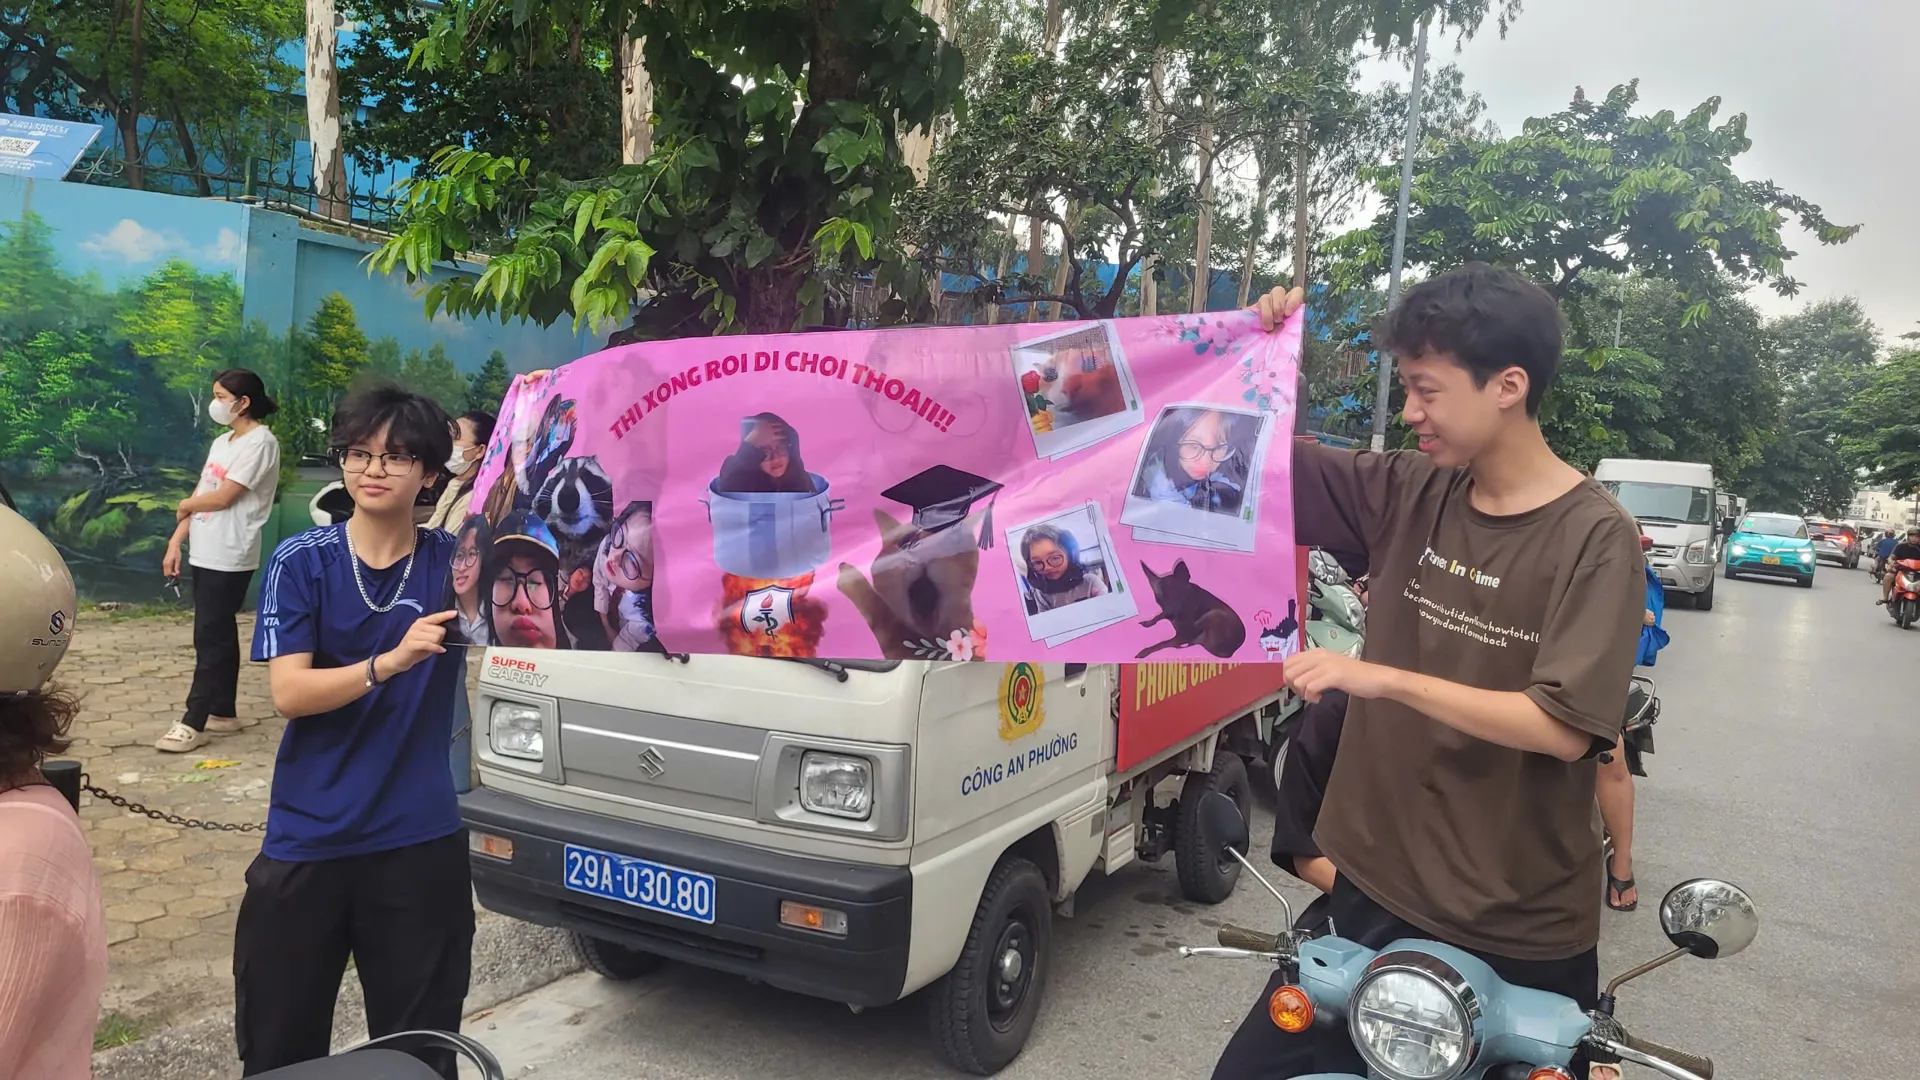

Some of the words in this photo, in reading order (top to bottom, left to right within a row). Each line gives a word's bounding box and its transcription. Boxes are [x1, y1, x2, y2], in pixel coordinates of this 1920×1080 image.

[608, 402, 644, 441] THI
[638, 365, 703, 414] XONG
[705, 353, 748, 383] ROI
[753, 350, 780, 372] DI
[784, 350, 848, 380] CHOI
[488, 665, 548, 688] CARRY
[491, 655, 536, 672] SUPER
[961, 763, 1003, 796] CÔNG
[1006, 753, 1025, 778] AN
[1028, 732, 1078, 768] PHƯỜNG
[567, 850, 710, 917] 29A-030.80
